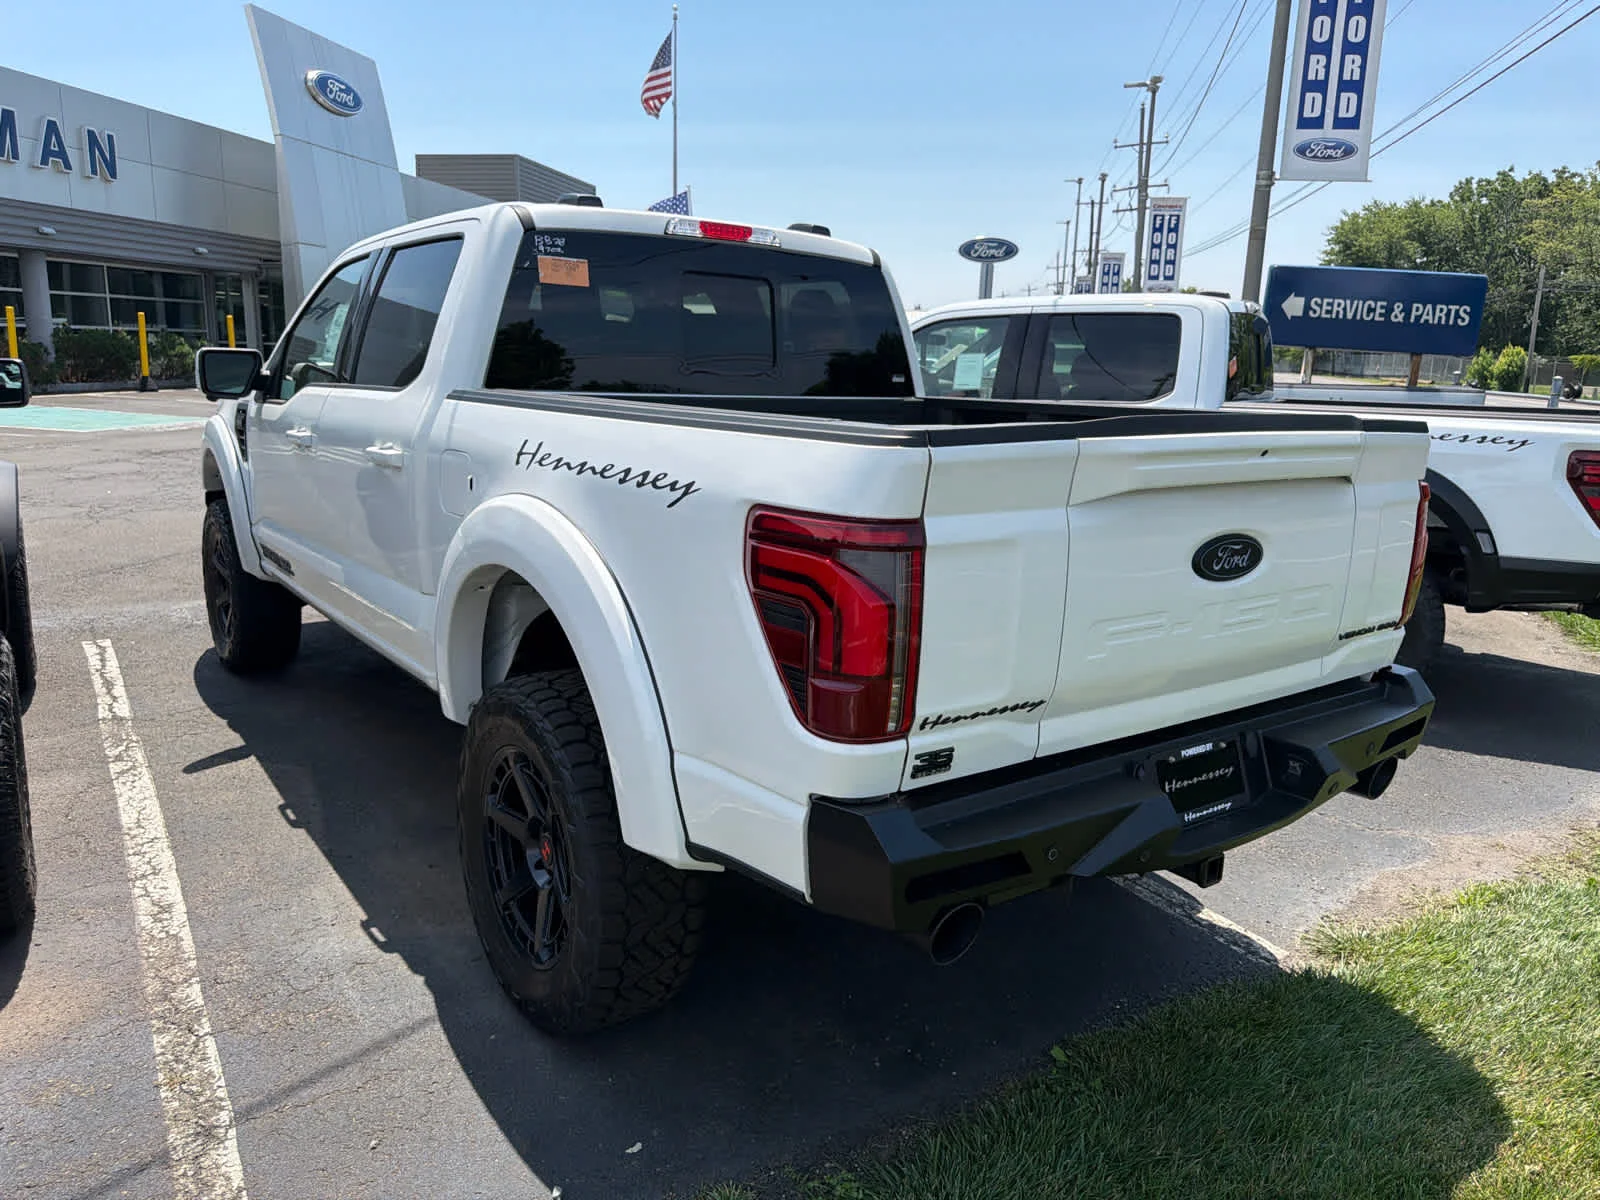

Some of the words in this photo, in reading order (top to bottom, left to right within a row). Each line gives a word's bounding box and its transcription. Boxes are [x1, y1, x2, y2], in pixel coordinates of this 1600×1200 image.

[1302, 0, 1331, 118] ORD
[1337, 0, 1367, 118] ORD
[1305, 141, 1346, 158] Ford
[970, 242, 1008, 257] Ford
[1150, 215, 1163, 277] FORD
[1164, 215, 1178, 277] FORD
[1308, 297, 1387, 321] SERVICE
[1390, 302, 1405, 323] &
[1409, 303, 1471, 326] PARTS
[1430, 433, 1537, 452] essey
[515, 439, 702, 509] Hennessey
[1212, 544, 1251, 570] Ford
[919, 700, 1047, 732] Hennessey
[1181, 745, 1206, 759] POWERED
[1165, 766, 1233, 793] Hennessey
[1184, 801, 1233, 822] Hennessey
